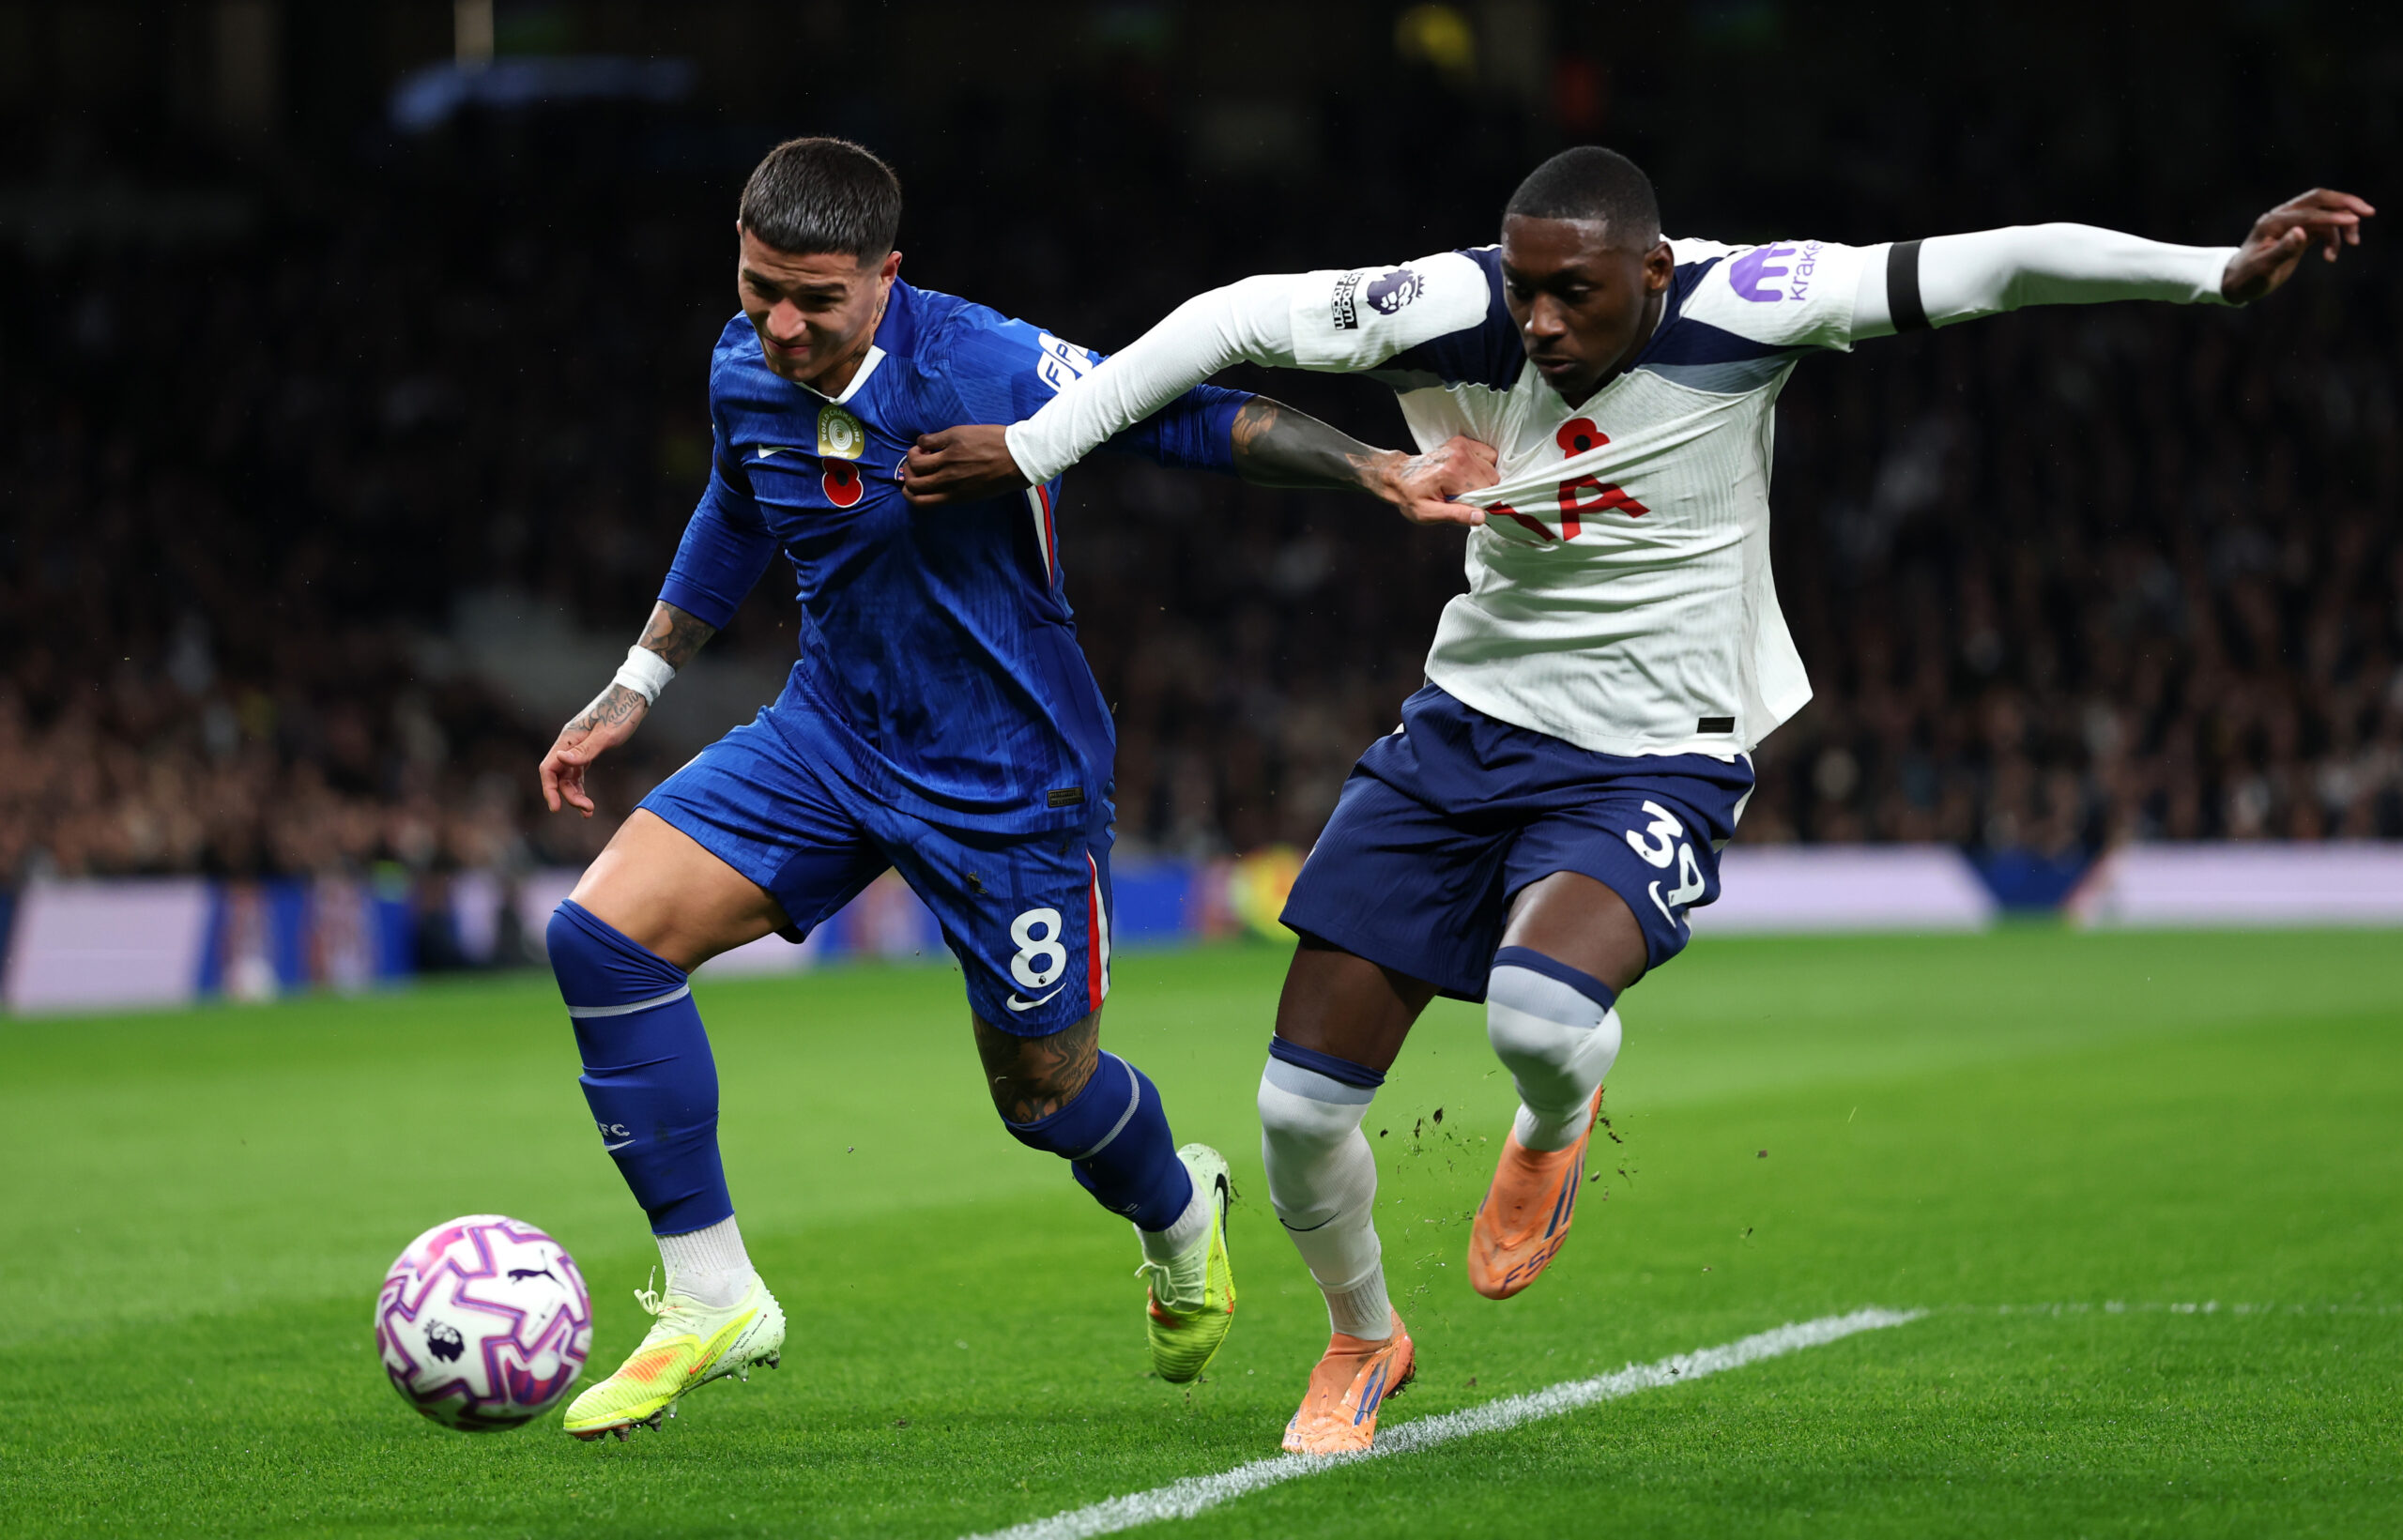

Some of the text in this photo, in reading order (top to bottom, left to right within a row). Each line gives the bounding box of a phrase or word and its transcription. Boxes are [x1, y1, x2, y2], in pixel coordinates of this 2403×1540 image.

[1789, 240, 1824, 300] krake
[1332, 285, 1346, 330] racism
[1342, 285, 1355, 324] room
[1046, 343, 1072, 388] FP
[821, 409, 861, 443] WORLD CHAMPIONS
[1010, 907, 1067, 988] 8
[598, 1121, 631, 1136] FC
